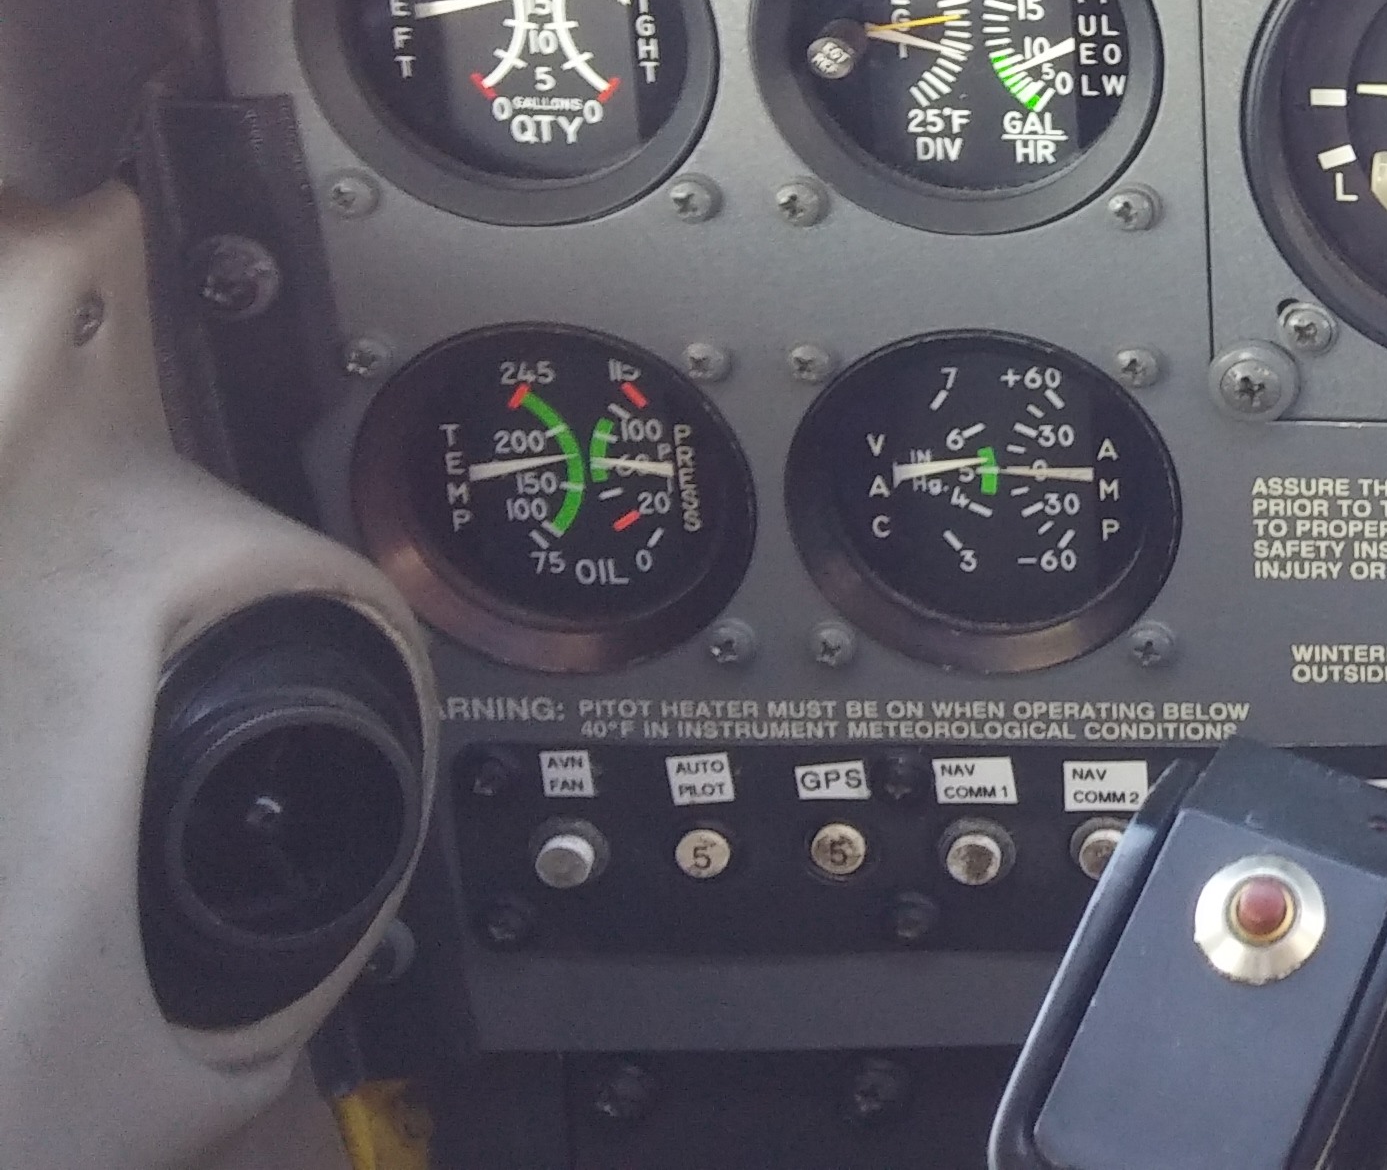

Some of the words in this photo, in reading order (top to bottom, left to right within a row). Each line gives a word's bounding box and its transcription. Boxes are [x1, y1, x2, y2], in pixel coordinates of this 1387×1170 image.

[510, 116, 584, 145] QTY
[1002, 112, 1064, 136] GAL
[916, 137, 964, 162] DIV
[1015, 140, 1057, 164] HR
[1252, 477, 1351, 496] ASSURE
[1252, 498, 1329, 517] PRIOR
[1336, 499, 1372, 518] TO
[1253, 518, 1287, 537] TO
[1253, 539, 1345, 559] SAFETY
[575, 558, 630, 585] OIL
[1253, 561, 1342, 580] INJURY
[1349, 561, 1386, 580] OR
[547, 757, 583, 769] AVN
[675, 761, 724, 776] AUTO
[940, 763, 975, 777] NAV
[799, 767, 865, 794] GPS
[1072, 768, 1107, 781] NAV
[550, 780, 584, 792] FAN
[679, 783, 726, 797] PILOT
[944, 785, 997, 800] COMM
[1073, 790, 1126, 804] COMM
